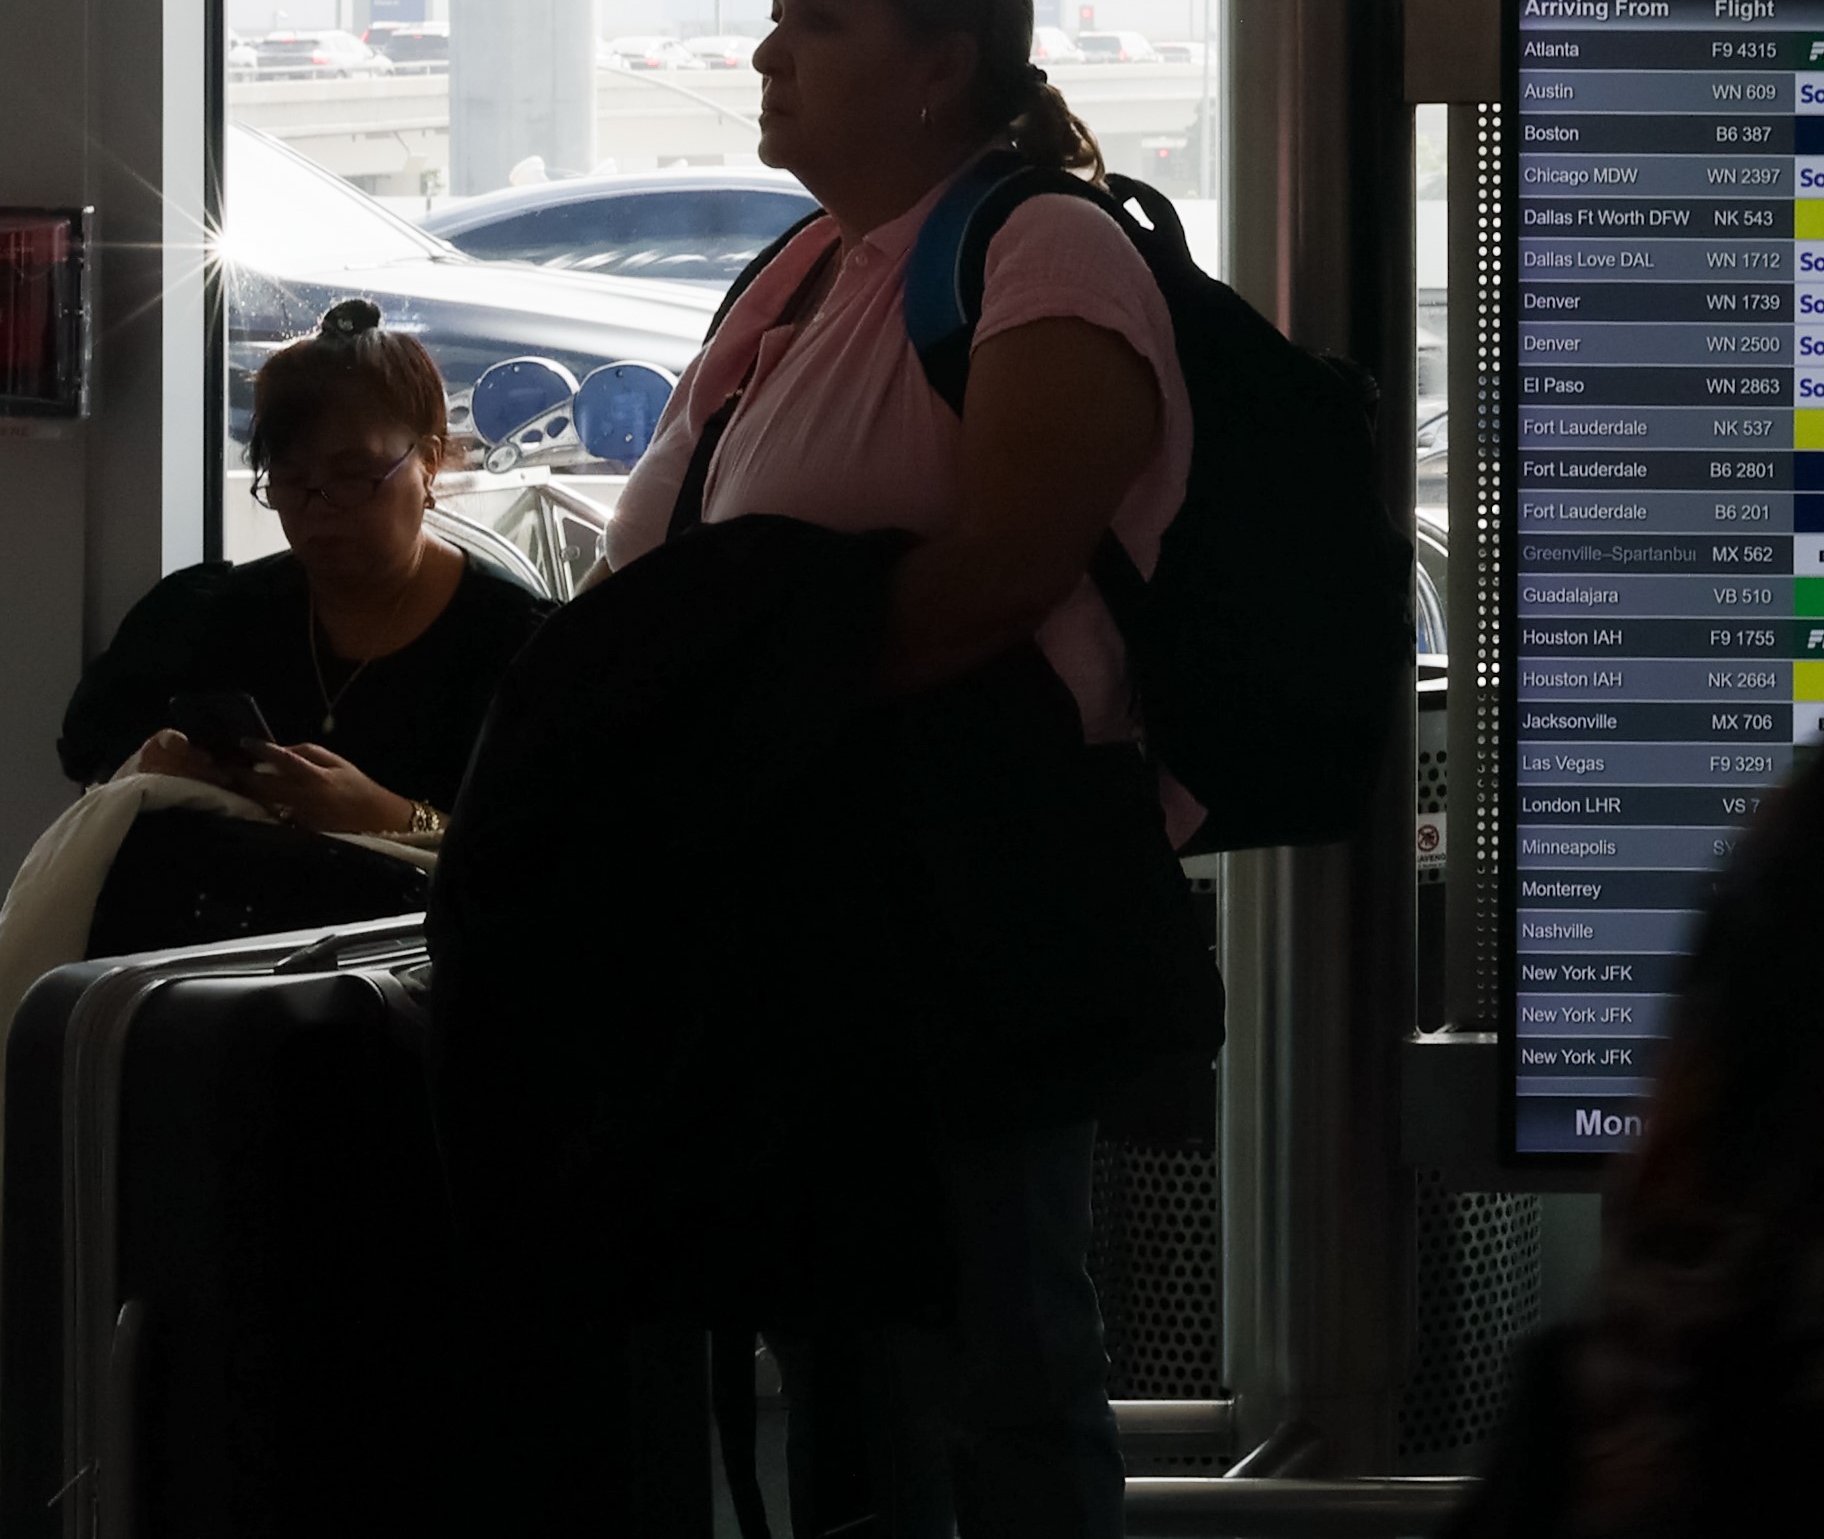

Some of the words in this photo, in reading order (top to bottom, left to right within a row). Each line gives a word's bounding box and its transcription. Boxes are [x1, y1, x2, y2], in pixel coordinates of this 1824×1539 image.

[1525, 0, 1612, 20] Arriving
[1619, 0, 1670, 17] From
[1714, 0, 1775, 22] Flight
[1525, 125, 1578, 141] Boston
[1717, 127, 1737, 141] B6
[1743, 127, 1771, 141] 387
